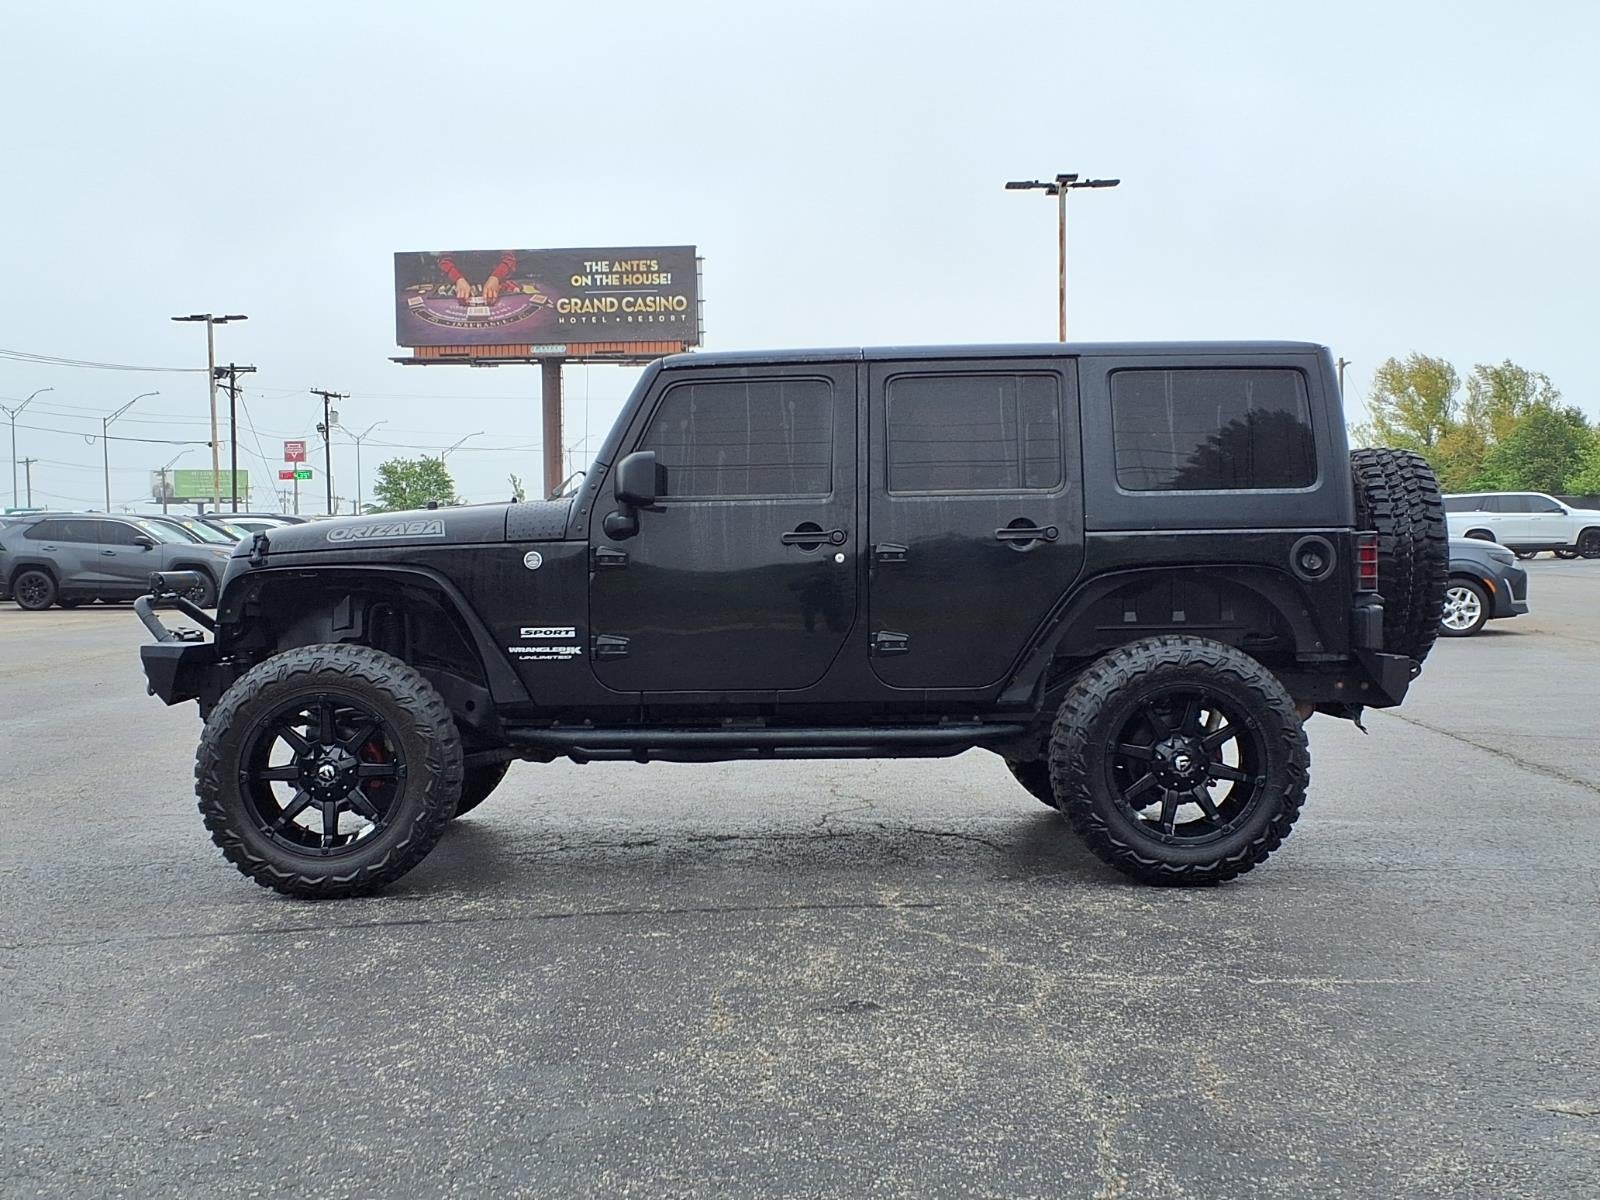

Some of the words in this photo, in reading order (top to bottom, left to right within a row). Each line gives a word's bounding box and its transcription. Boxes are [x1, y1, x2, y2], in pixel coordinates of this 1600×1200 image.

[584, 261, 610, 273] THE
[612, 260, 659, 272] ANTE'S
[571, 275, 592, 286] ON
[594, 274, 620, 286] THE
[622, 273, 672, 285] HOUSE!
[556, 297, 619, 314] GRAND
[621, 295, 688, 312] CASINO
[558, 316, 607, 324] HOTEL
[627, 314, 687, 323] RESORT
[329, 520, 443, 540] ORIZABA
